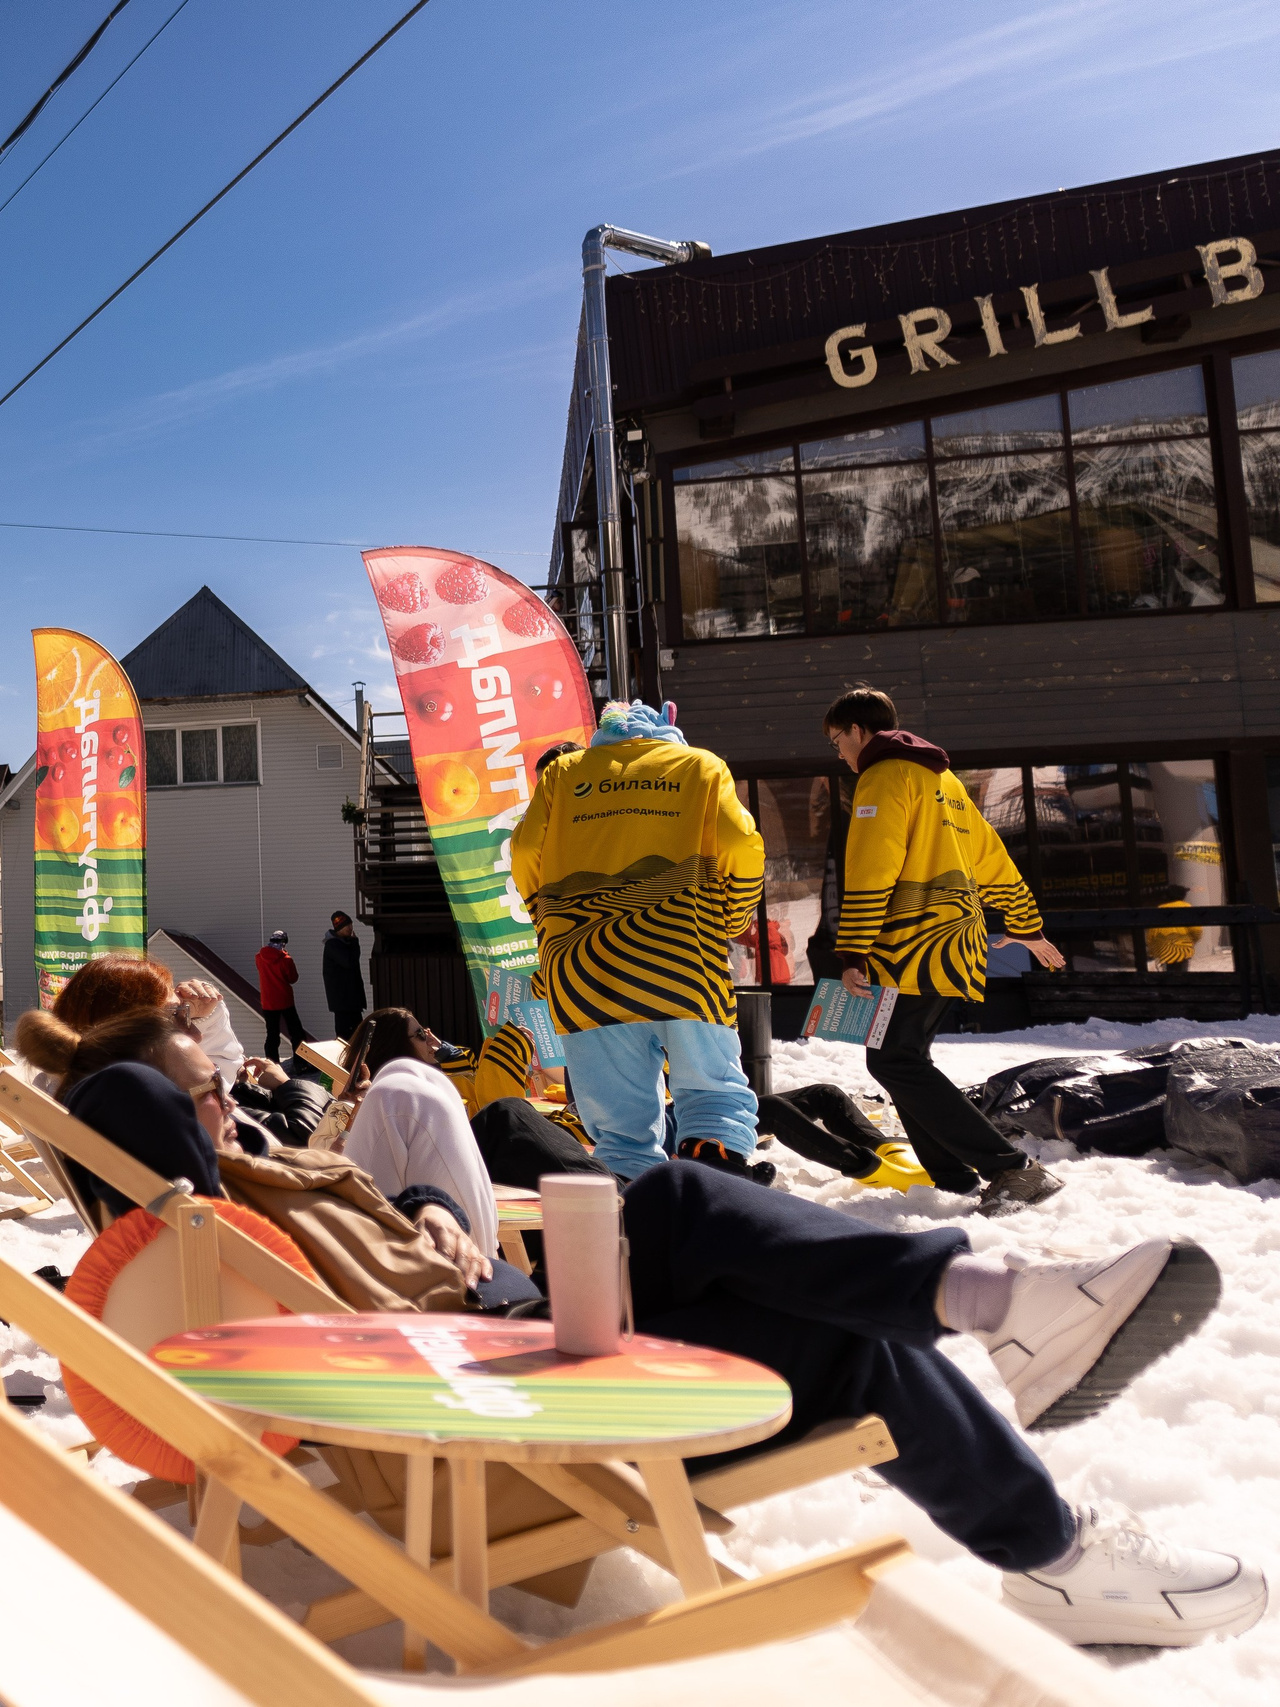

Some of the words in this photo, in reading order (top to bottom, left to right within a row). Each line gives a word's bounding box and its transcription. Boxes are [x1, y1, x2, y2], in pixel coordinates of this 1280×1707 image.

[824, 266, 1155, 388] GRILL
[1195, 236, 1265, 308] B
[598, 777, 681, 793] билайн
[572, 807, 681, 823] #билайнсоединяет
[493, 969, 501, 987] 2024
[818, 981, 830, 1000] 2024
[822, 985, 842, 1031] БЛАГОДАРНОСТЬ
[829, 987, 849, 1033] ВОЛОНТЕРУ
[529, 1007, 549, 1059] БЛАГОДАРНОСТЬ
[535, 1007, 555, 1058] ВОЛОНТЕРУ
